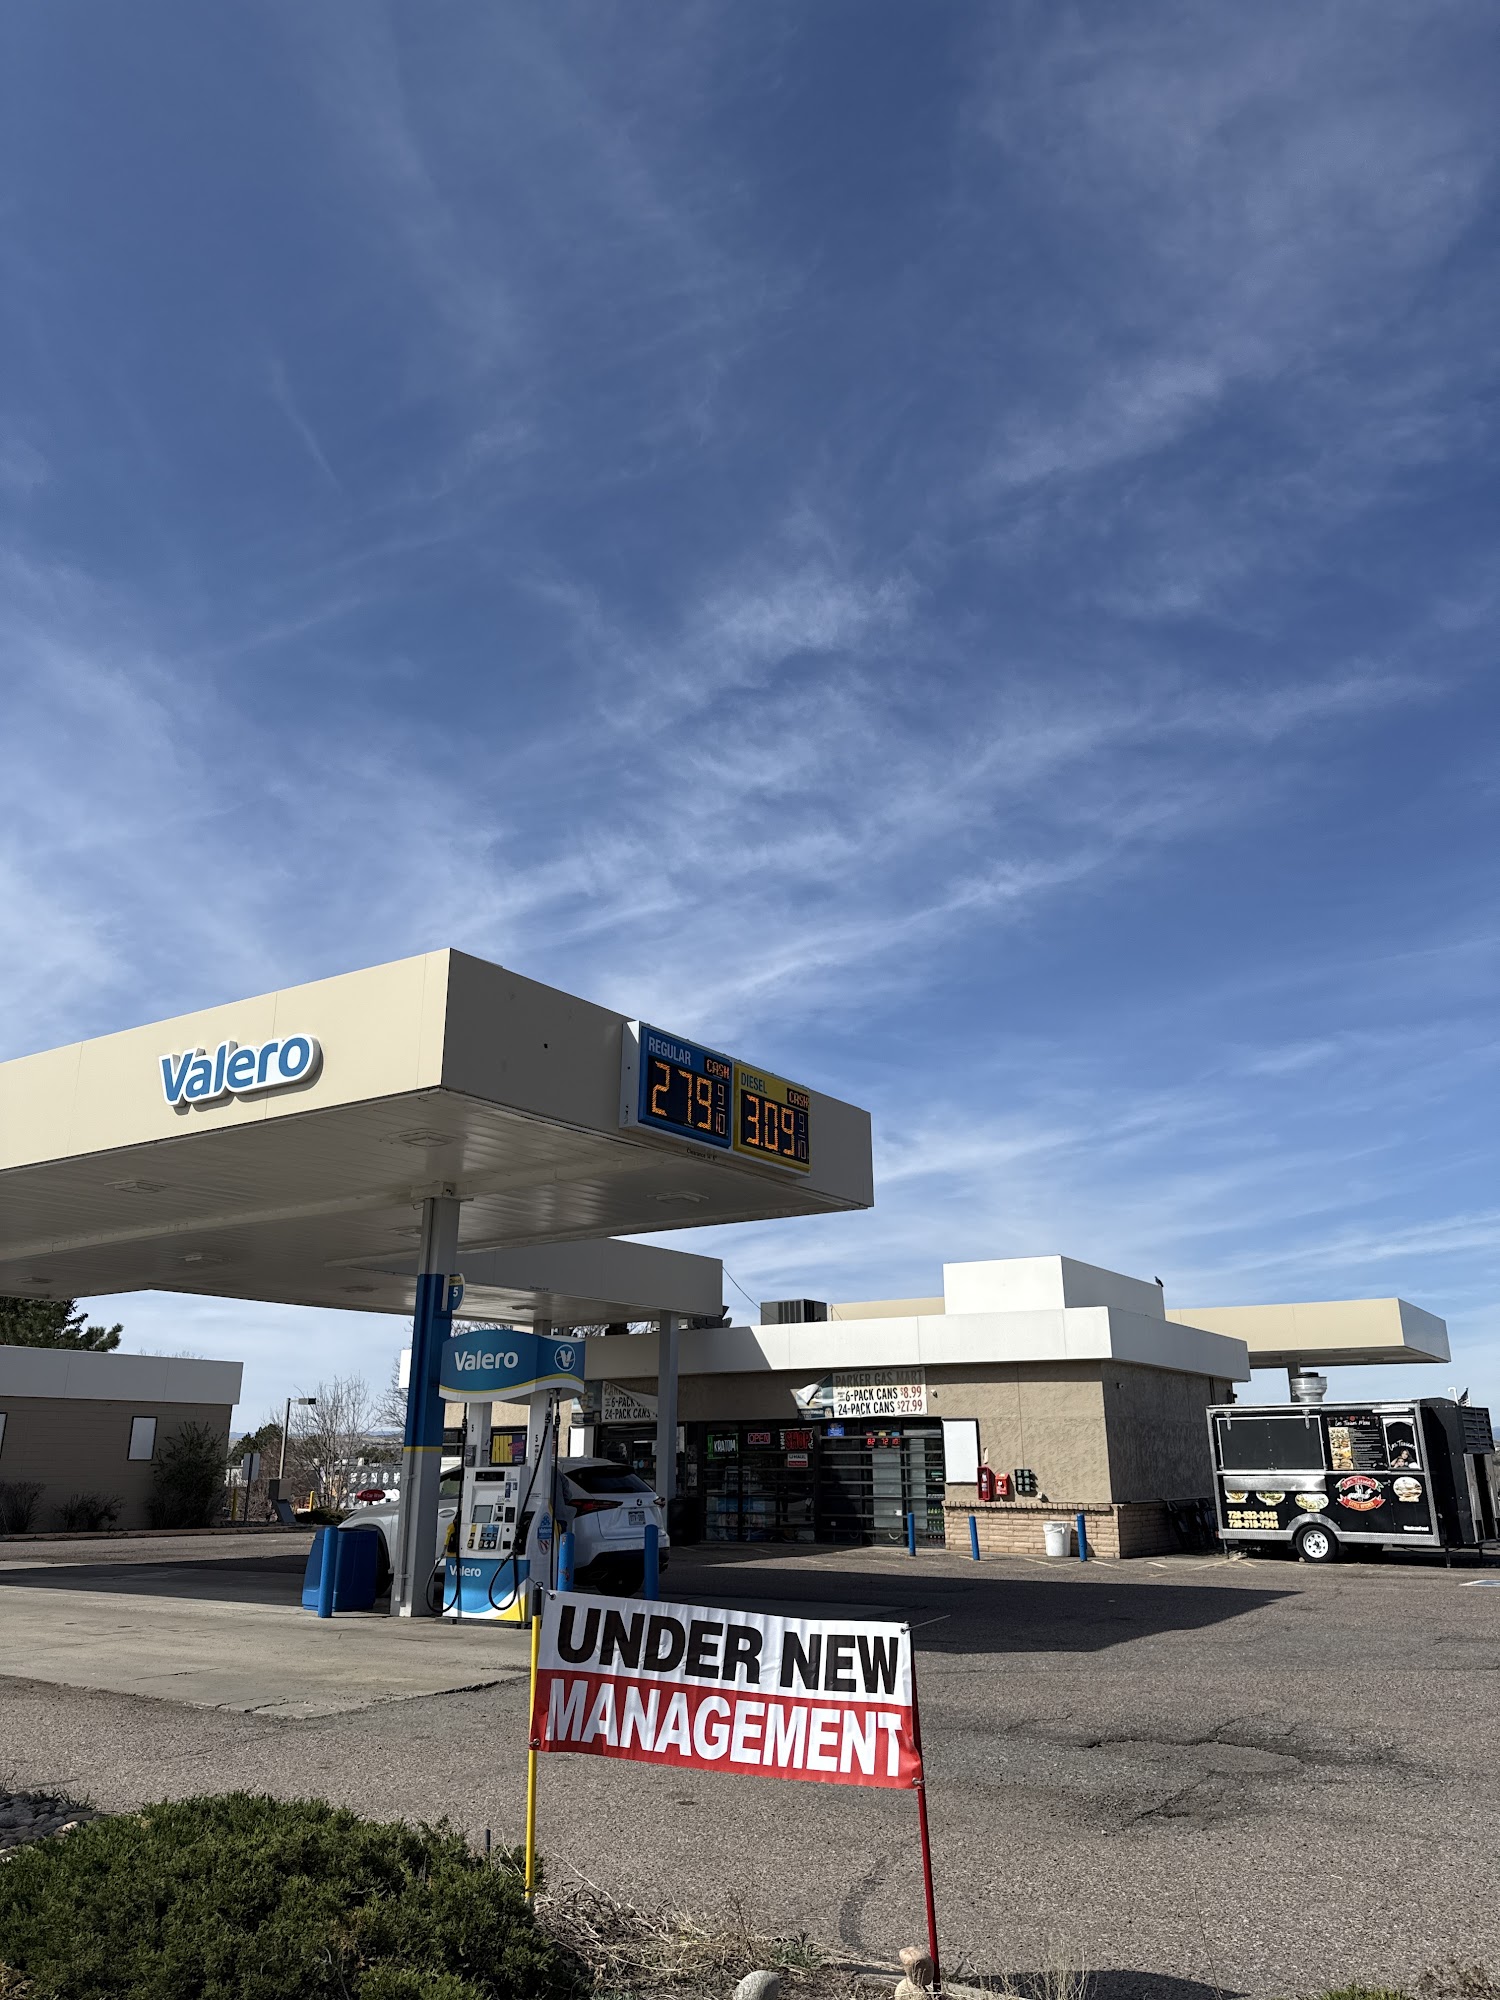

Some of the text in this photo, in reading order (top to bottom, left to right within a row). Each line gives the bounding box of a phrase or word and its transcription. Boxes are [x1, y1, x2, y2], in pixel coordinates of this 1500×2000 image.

[648, 1036, 692, 1066] REGULAR
[161, 1036, 310, 1102] Valero
[706, 1058, 730, 1080] CASH
[740, 1072, 768, 1095] DIESEL
[651, 1060, 712, 1131] 279
[788, 1090, 809, 1107] CASH
[746, 1094, 795, 1157] 3.09
[452, 1286, 459, 1298] 5
[454, 1350, 519, 1371] Valero
[835, 1369, 923, 1389] PARKER GAS MART
[611, 1396, 635, 1408] 6-PACK
[845, 1388, 874, 1402] 6-PACK
[876, 1387, 898, 1401] CANS
[900, 1385, 922, 1399] $8.99
[604, 1407, 651, 1420] 24-PACK CANS
[837, 1402, 871, 1416] 24-PACK
[873, 1400, 895, 1414] CANS
[897, 1399, 923, 1413] $27.99
[470, 1424, 475, 1433] 5
[535, 1434, 539, 1442] 5
[749, 1433, 769, 1443] OPEN
[785, 1431, 810, 1450] SHOP
[449, 1564, 481, 1578] Vlero
[557, 1604, 900, 1695] UNDER NEW
[545, 1677, 902, 1777] MANAGEMENT
